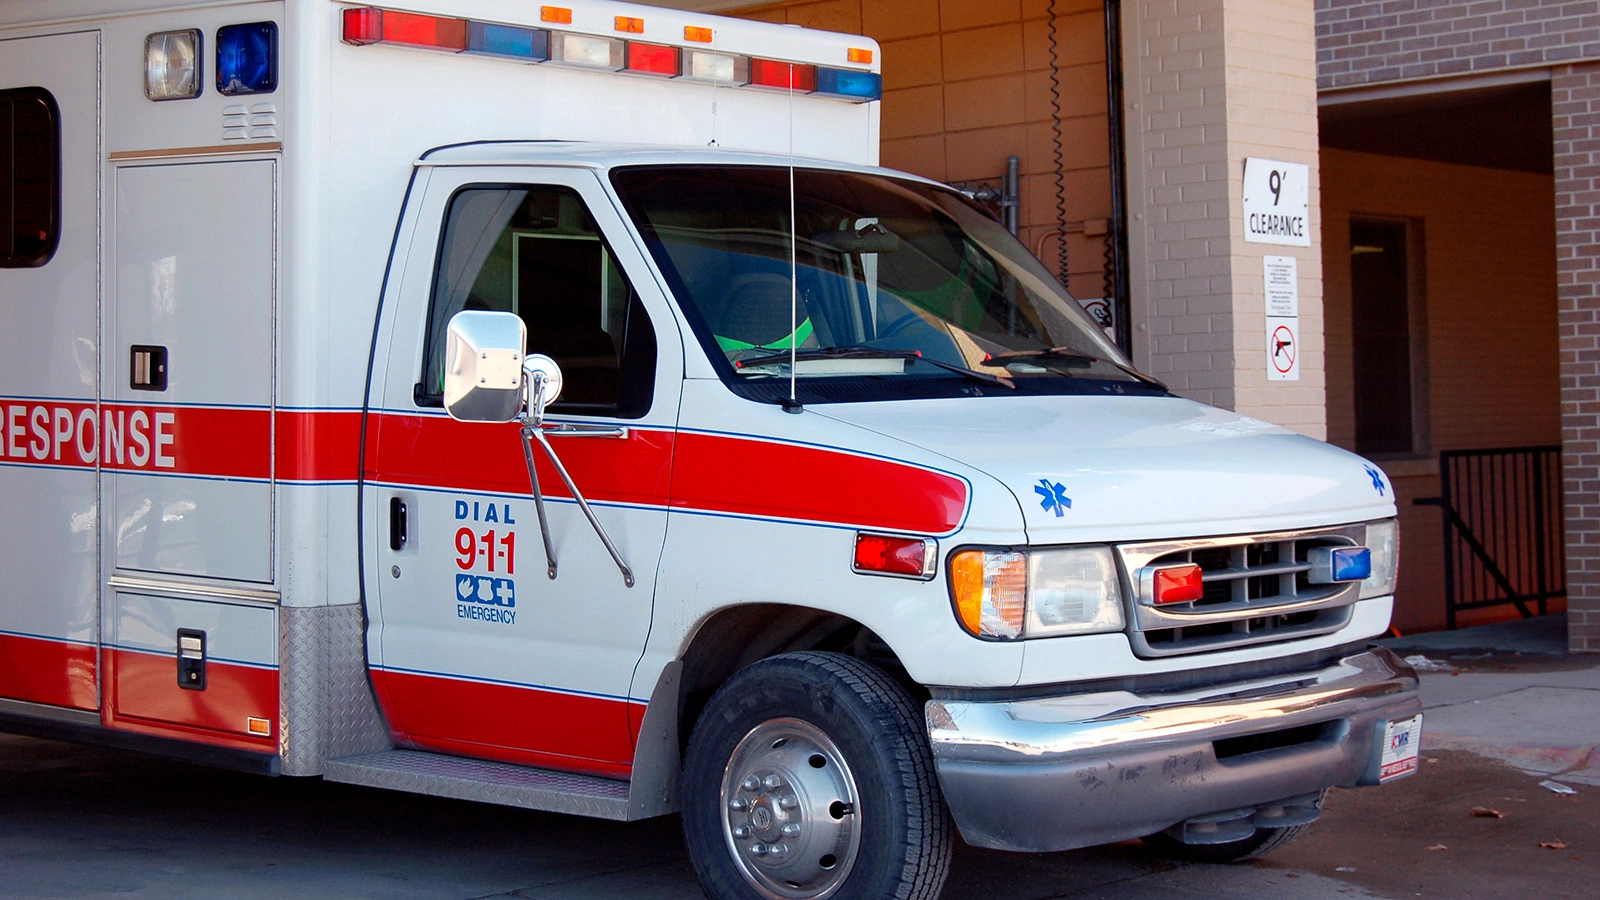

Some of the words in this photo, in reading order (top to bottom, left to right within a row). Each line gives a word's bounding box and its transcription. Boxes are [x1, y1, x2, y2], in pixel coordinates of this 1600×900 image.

[1269, 169, 1287, 206] 9'
[1249, 213, 1303, 237] CLEARANCE
[0, 405, 175, 468] ESPONSE
[455, 500, 516, 524] DIAL
[455, 527, 515, 574] 9-1-1
[457, 604, 516, 624] EMERGENCY
